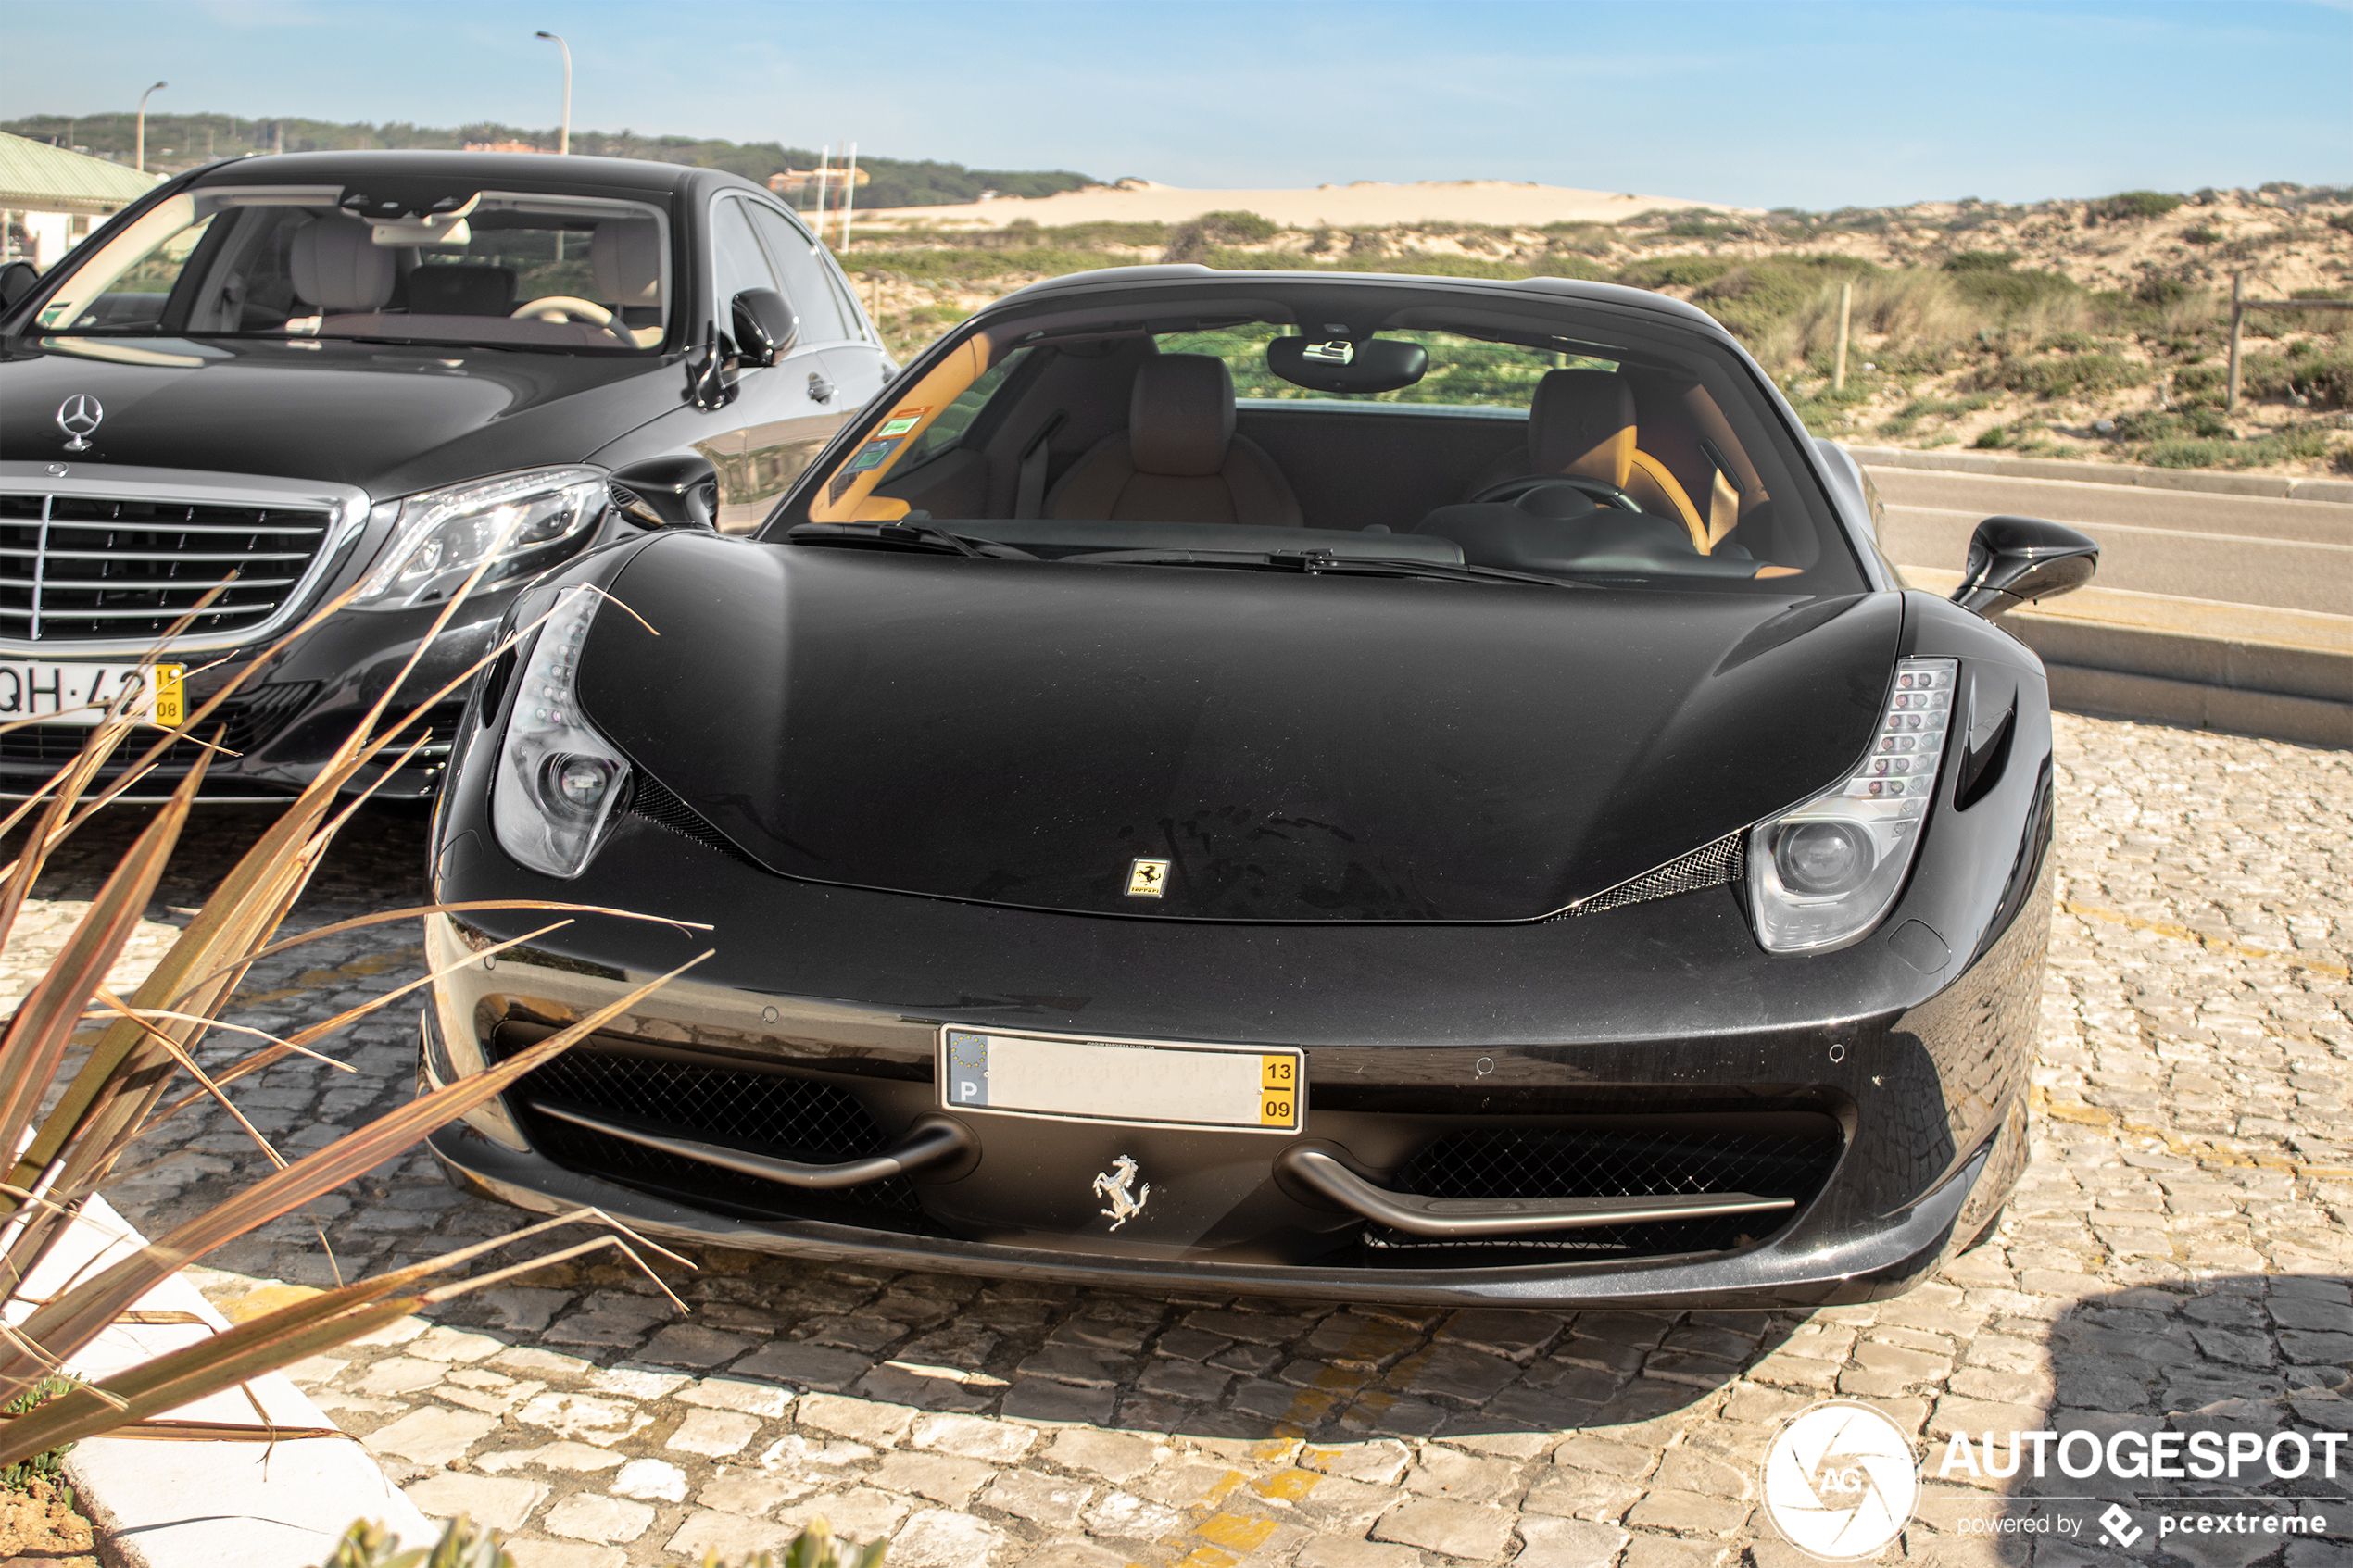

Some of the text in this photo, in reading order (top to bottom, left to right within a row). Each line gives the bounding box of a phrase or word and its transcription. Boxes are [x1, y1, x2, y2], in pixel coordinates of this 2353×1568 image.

[157, 702, 176, 717] 08
[1268, 1063, 1291, 1080] 13
[961, 1081, 978, 1101] P
[1265, 1101, 1290, 1118] 09
